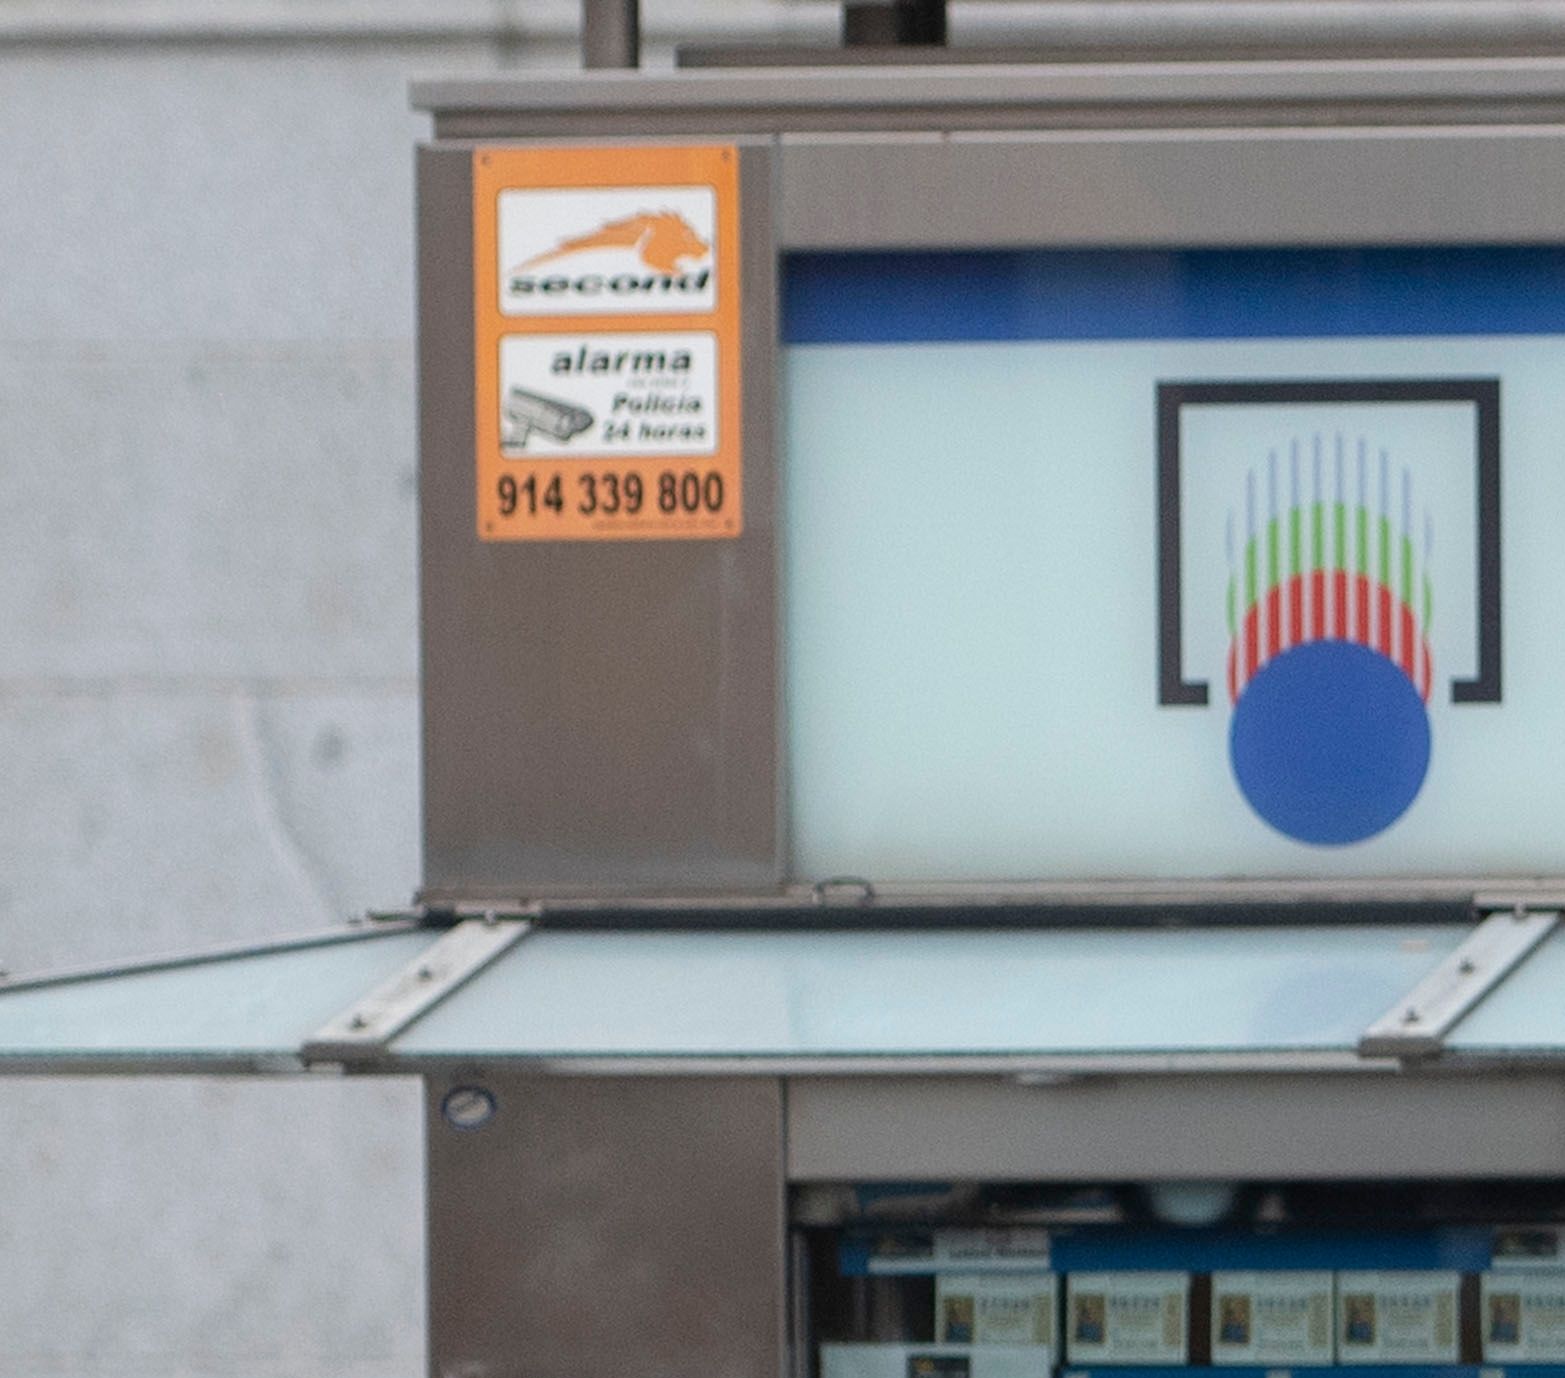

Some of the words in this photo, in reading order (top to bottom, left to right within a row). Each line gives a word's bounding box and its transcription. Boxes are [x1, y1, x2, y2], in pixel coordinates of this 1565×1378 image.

[509, 271, 711, 295] second
[551, 344, 692, 375] alarma
[603, 420, 630, 441] 24
[639, 419, 706, 441] horas
[498, 473, 564, 516] 914
[579, 472, 643, 515] 339
[659, 471, 724, 513] 800
